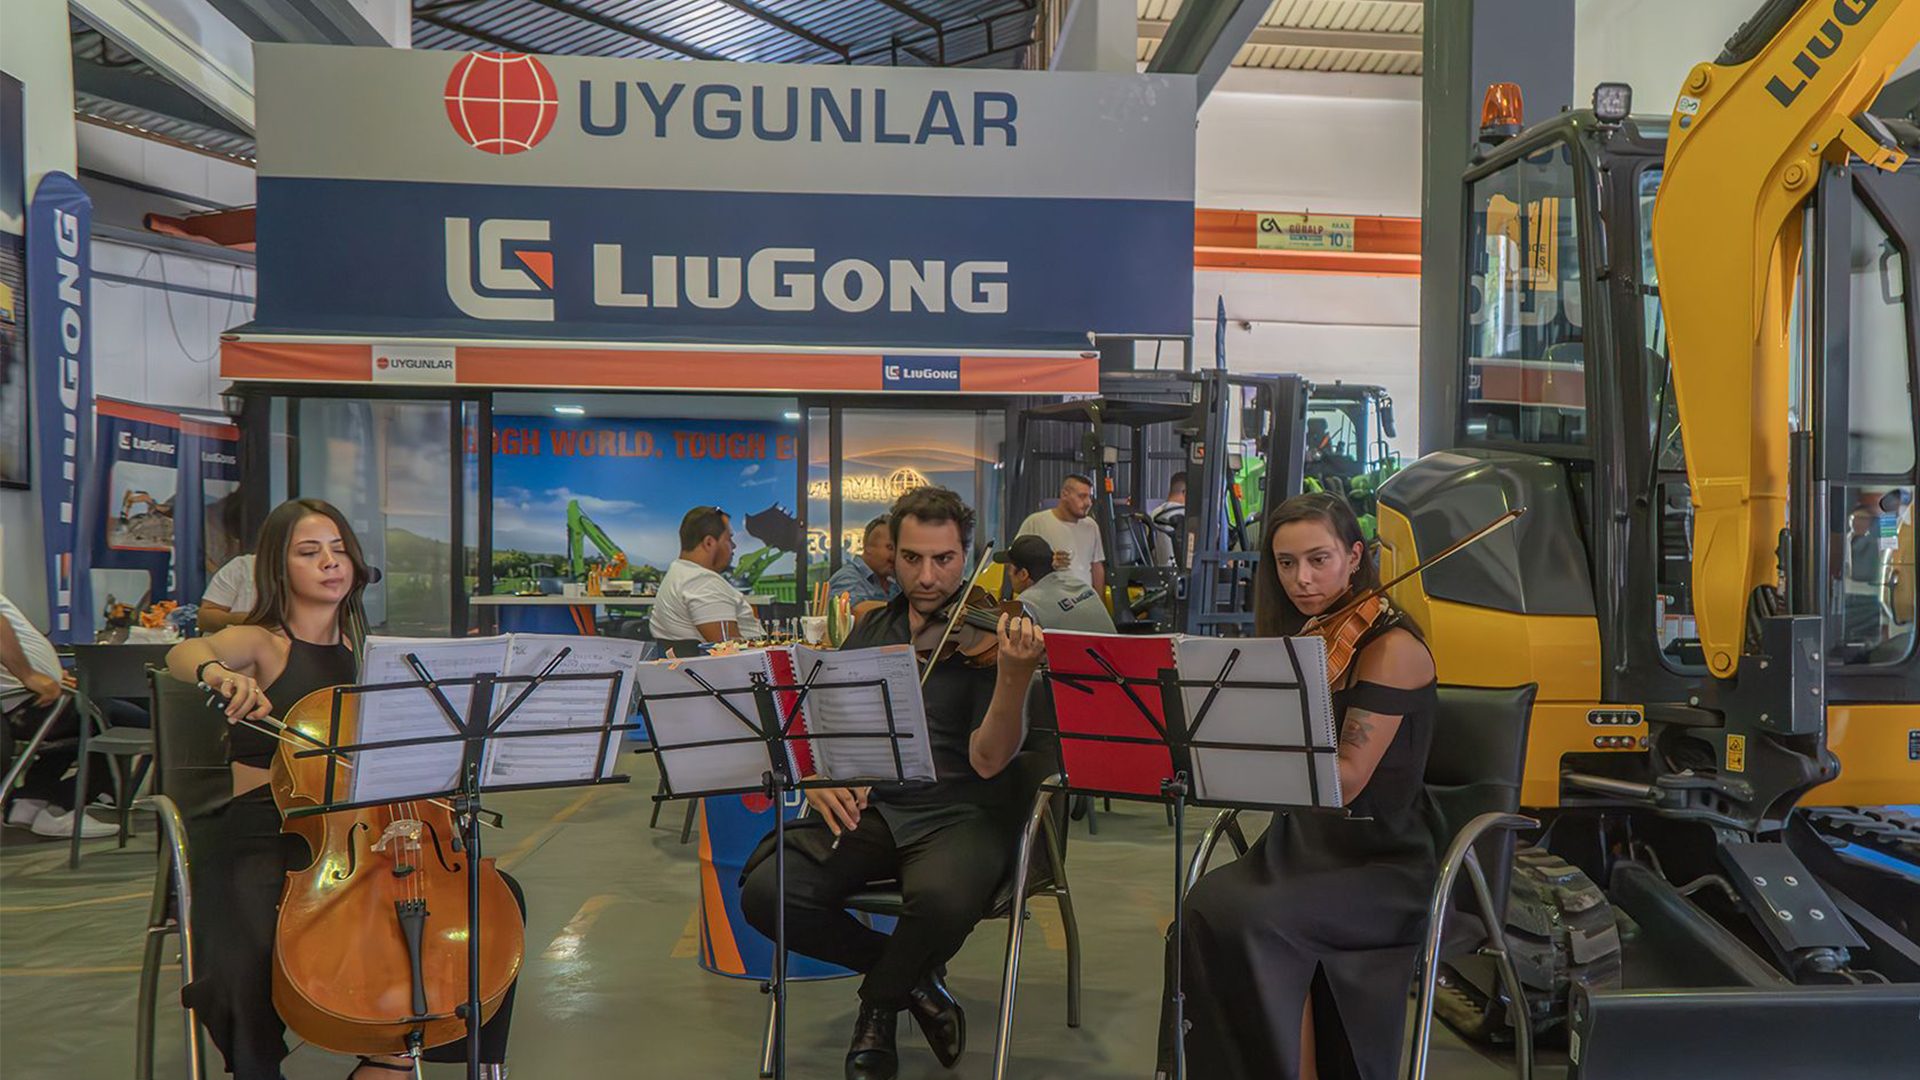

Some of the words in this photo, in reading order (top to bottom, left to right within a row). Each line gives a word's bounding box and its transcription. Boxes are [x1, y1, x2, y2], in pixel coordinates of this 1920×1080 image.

[579, 79, 1018, 147] UYGUNLAR
[1328, 232, 1344, 247] 10
[391, 359, 453, 369] UYGUNLAR
[551, 430, 662, 458] WORLD.
[673, 431, 766, 460] TOUGH
